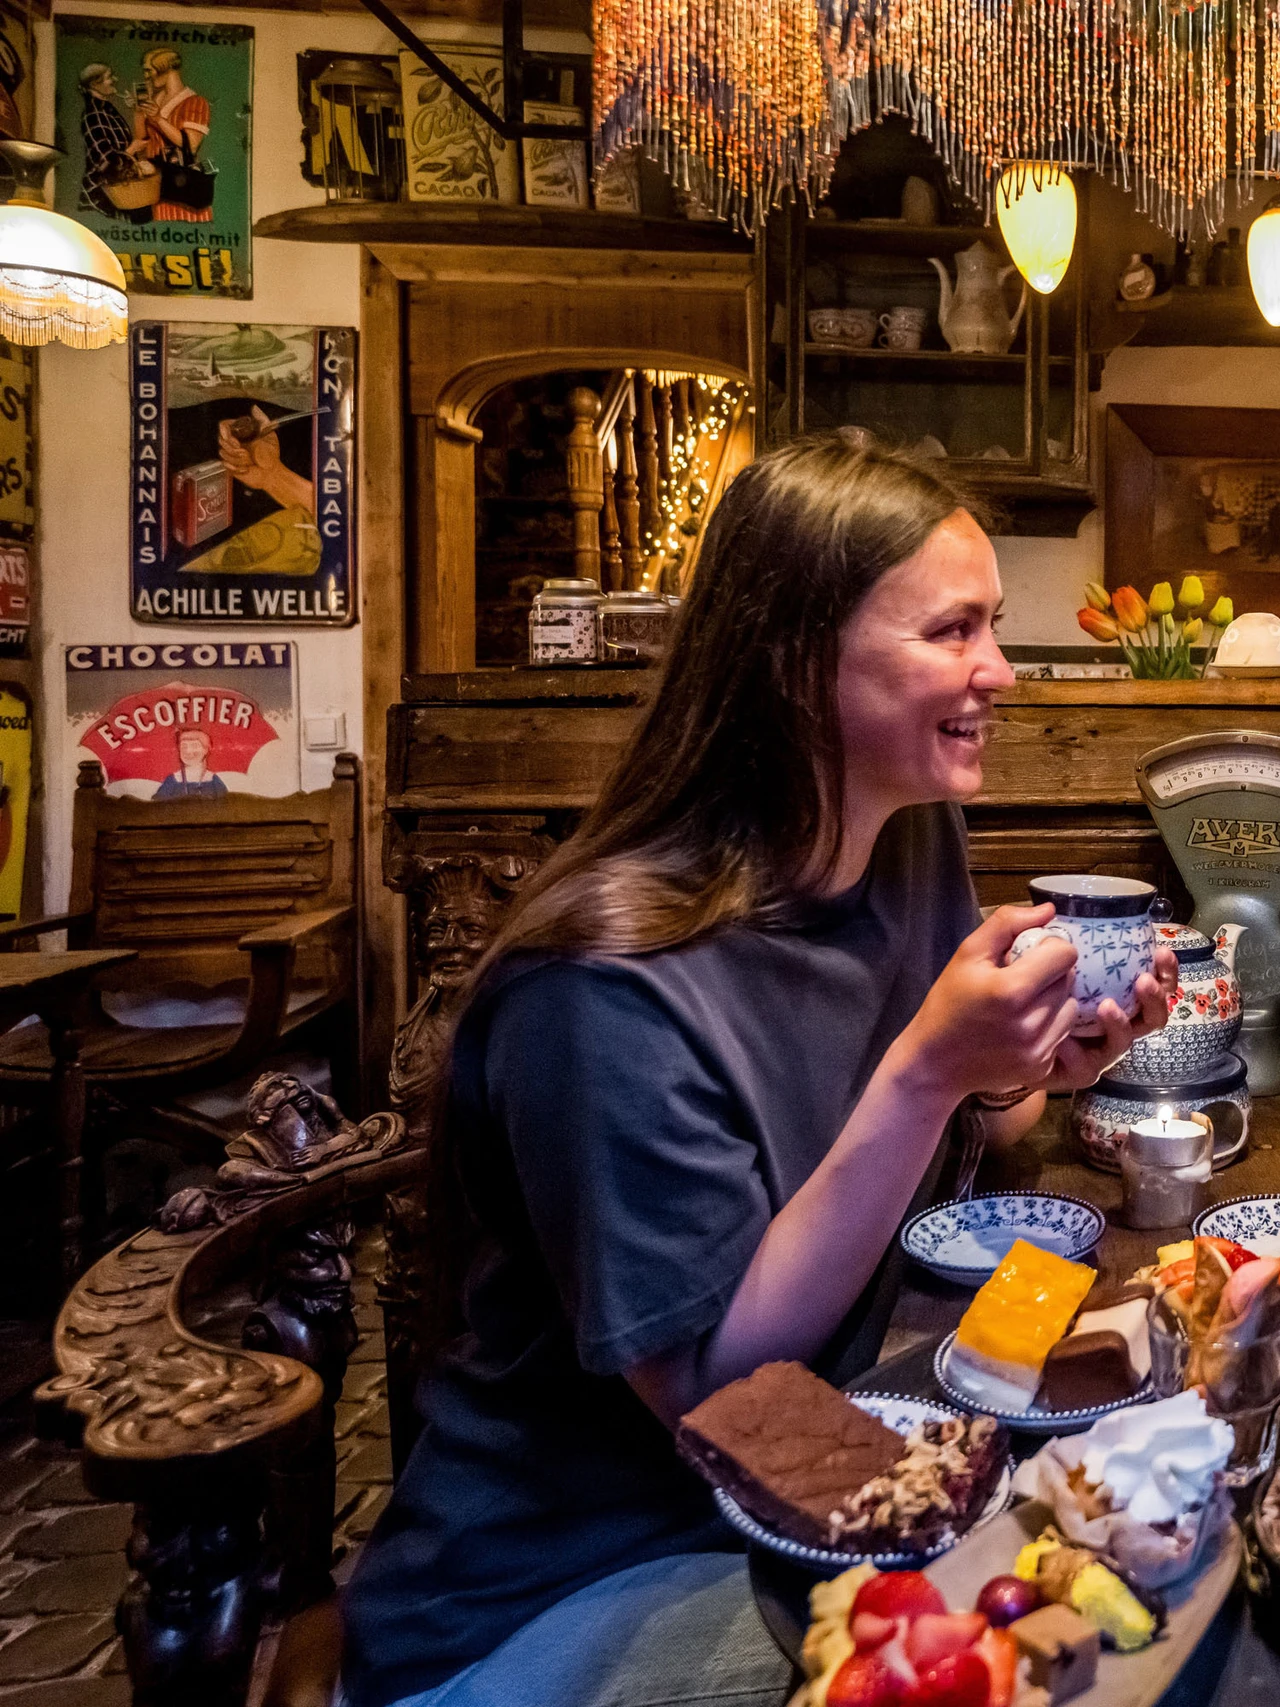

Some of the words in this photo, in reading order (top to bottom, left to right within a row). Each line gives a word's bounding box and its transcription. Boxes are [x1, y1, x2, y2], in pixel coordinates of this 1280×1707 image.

[414, 181, 477, 197] CACAO
[209, 233, 240, 247] mit
[139, 329, 157, 367] LE
[137, 382, 157, 564] BOHANNAIS
[322, 436, 344, 538] TABAC
[137, 588, 244, 615] ACHILLE
[253, 589, 346, 617] WELLE
[68, 644, 287, 669] CHOCOLAT
[97, 697, 254, 750] ESCOFFIER
